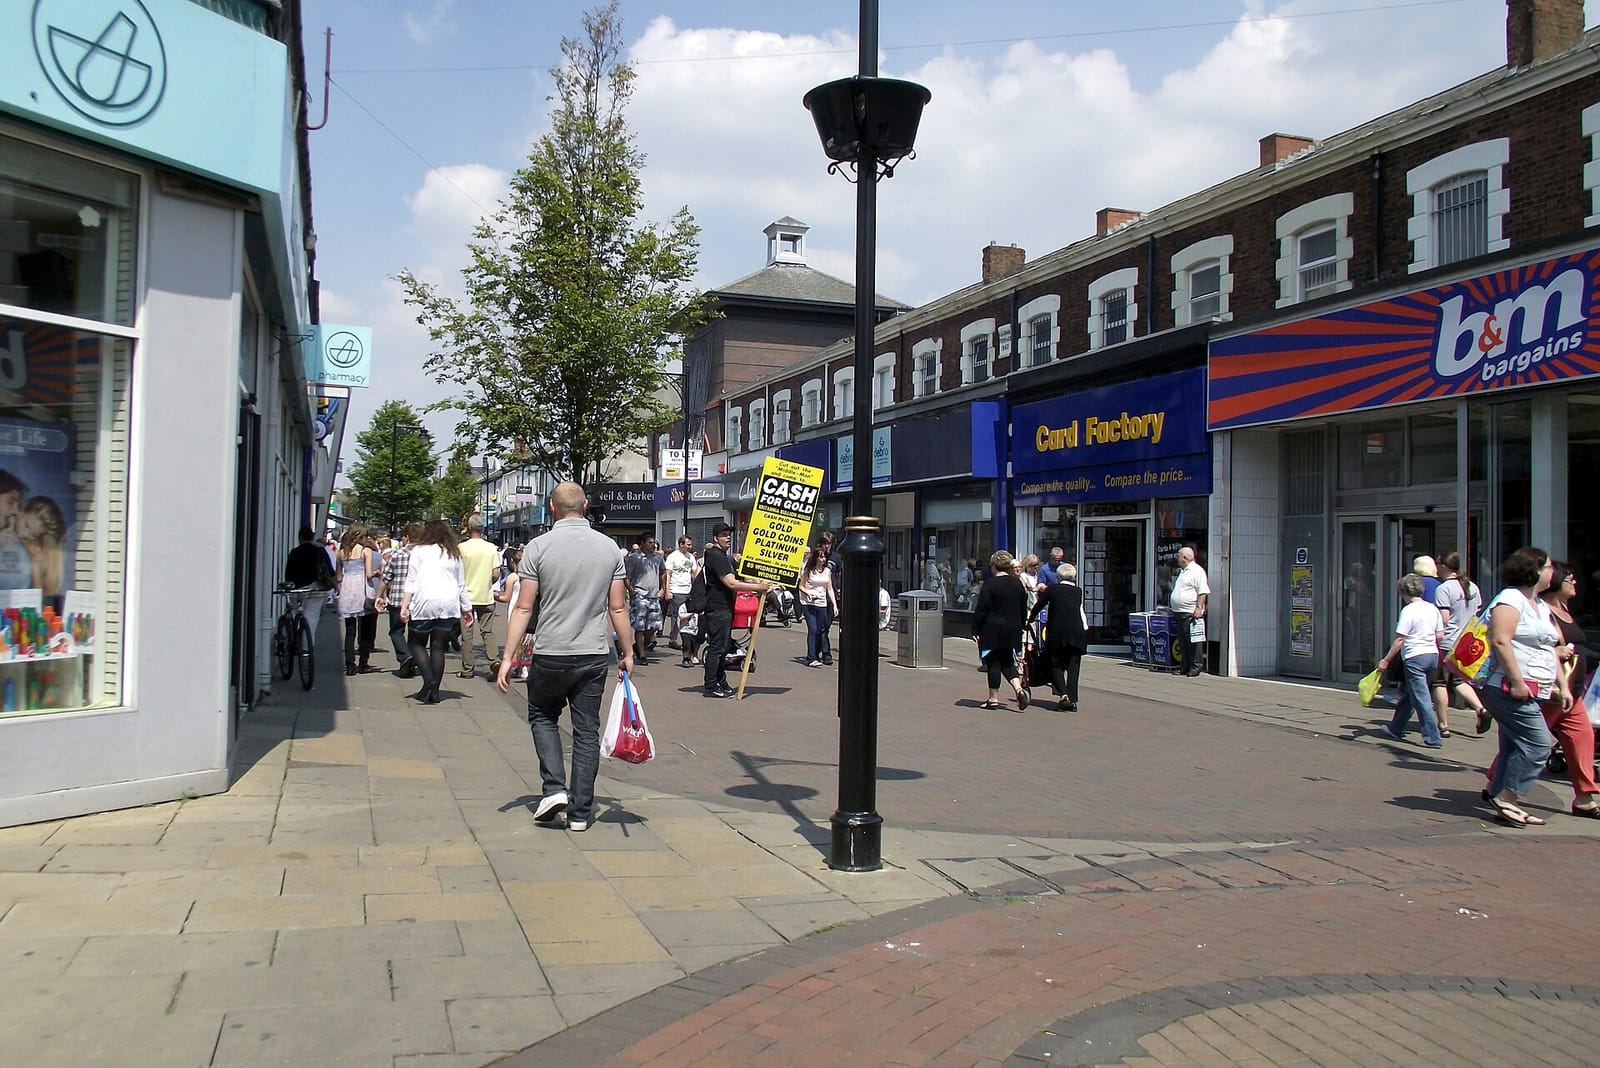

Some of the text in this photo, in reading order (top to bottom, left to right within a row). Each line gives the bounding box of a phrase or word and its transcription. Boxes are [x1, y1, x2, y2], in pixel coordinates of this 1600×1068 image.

[1436, 269, 1588, 376] b&m
[1482, 331, 1583, 382] bargains
[319, 371, 366, 384] pharmacy
[16, 429, 48, 446] Life
[1036, 411, 1165, 452] Card Factory
[764, 478, 817, 504] CASH
[1021, 482, 1051, 496] Compare
[1051, 480, 1063, 492] the
[1104, 474, 1141, 489] Compare
[1144, 471, 1158, 484] the
[616, 492, 624, 500] &
[760, 494, 813, 514] FOR GOLD
[610, 503, 640, 511] Jewellers
[769, 522, 792, 533] GOLD
[753, 528, 804, 545] GOLD COINS
[755, 538, 798, 554] PLATINUM
[760, 548, 789, 561] SILVER
[755, 564, 778, 573] WIDNES
[757, 571, 781, 580] WIDNES
